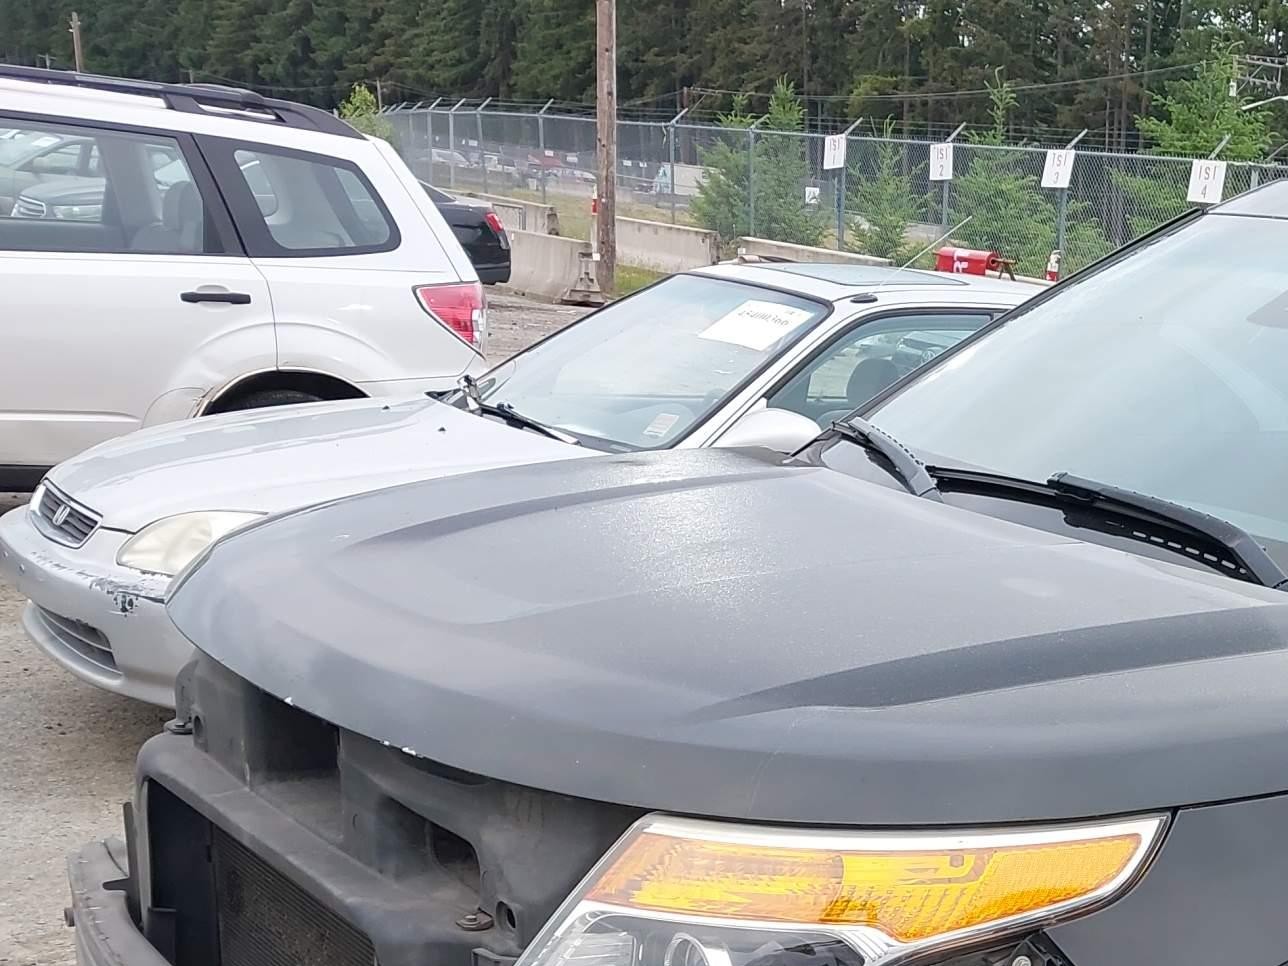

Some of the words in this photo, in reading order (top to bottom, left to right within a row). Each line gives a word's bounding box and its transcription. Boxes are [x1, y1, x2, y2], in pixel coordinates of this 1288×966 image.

[938, 164, 945, 177] 2
[1053, 171, 1060, 184] 3
[1201, 184, 1208, 199] 4
